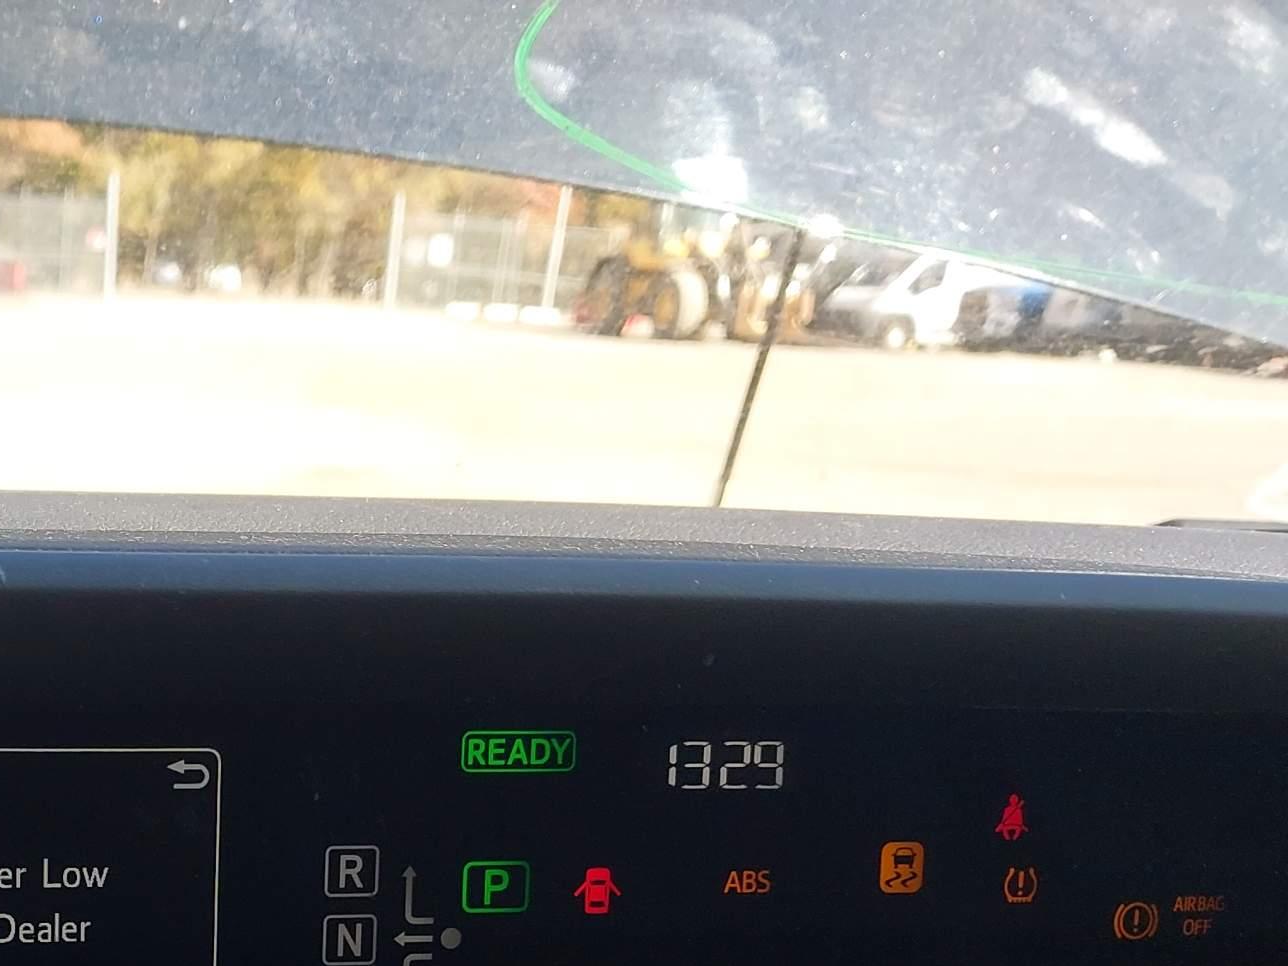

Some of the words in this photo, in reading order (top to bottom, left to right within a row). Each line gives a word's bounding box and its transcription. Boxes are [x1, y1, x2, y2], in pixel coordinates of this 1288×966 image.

[468, 739, 569, 765] READY
[44, 858, 108, 888] Low
[339, 855, 363, 888] R
[724, 871, 770, 893] ABS
[484, 869, 509, 905] P
[1173, 896, 1223, 912] AIRBAG
[338, 923, 362, 956] N
[1182, 918, 1212, 936] OFF
